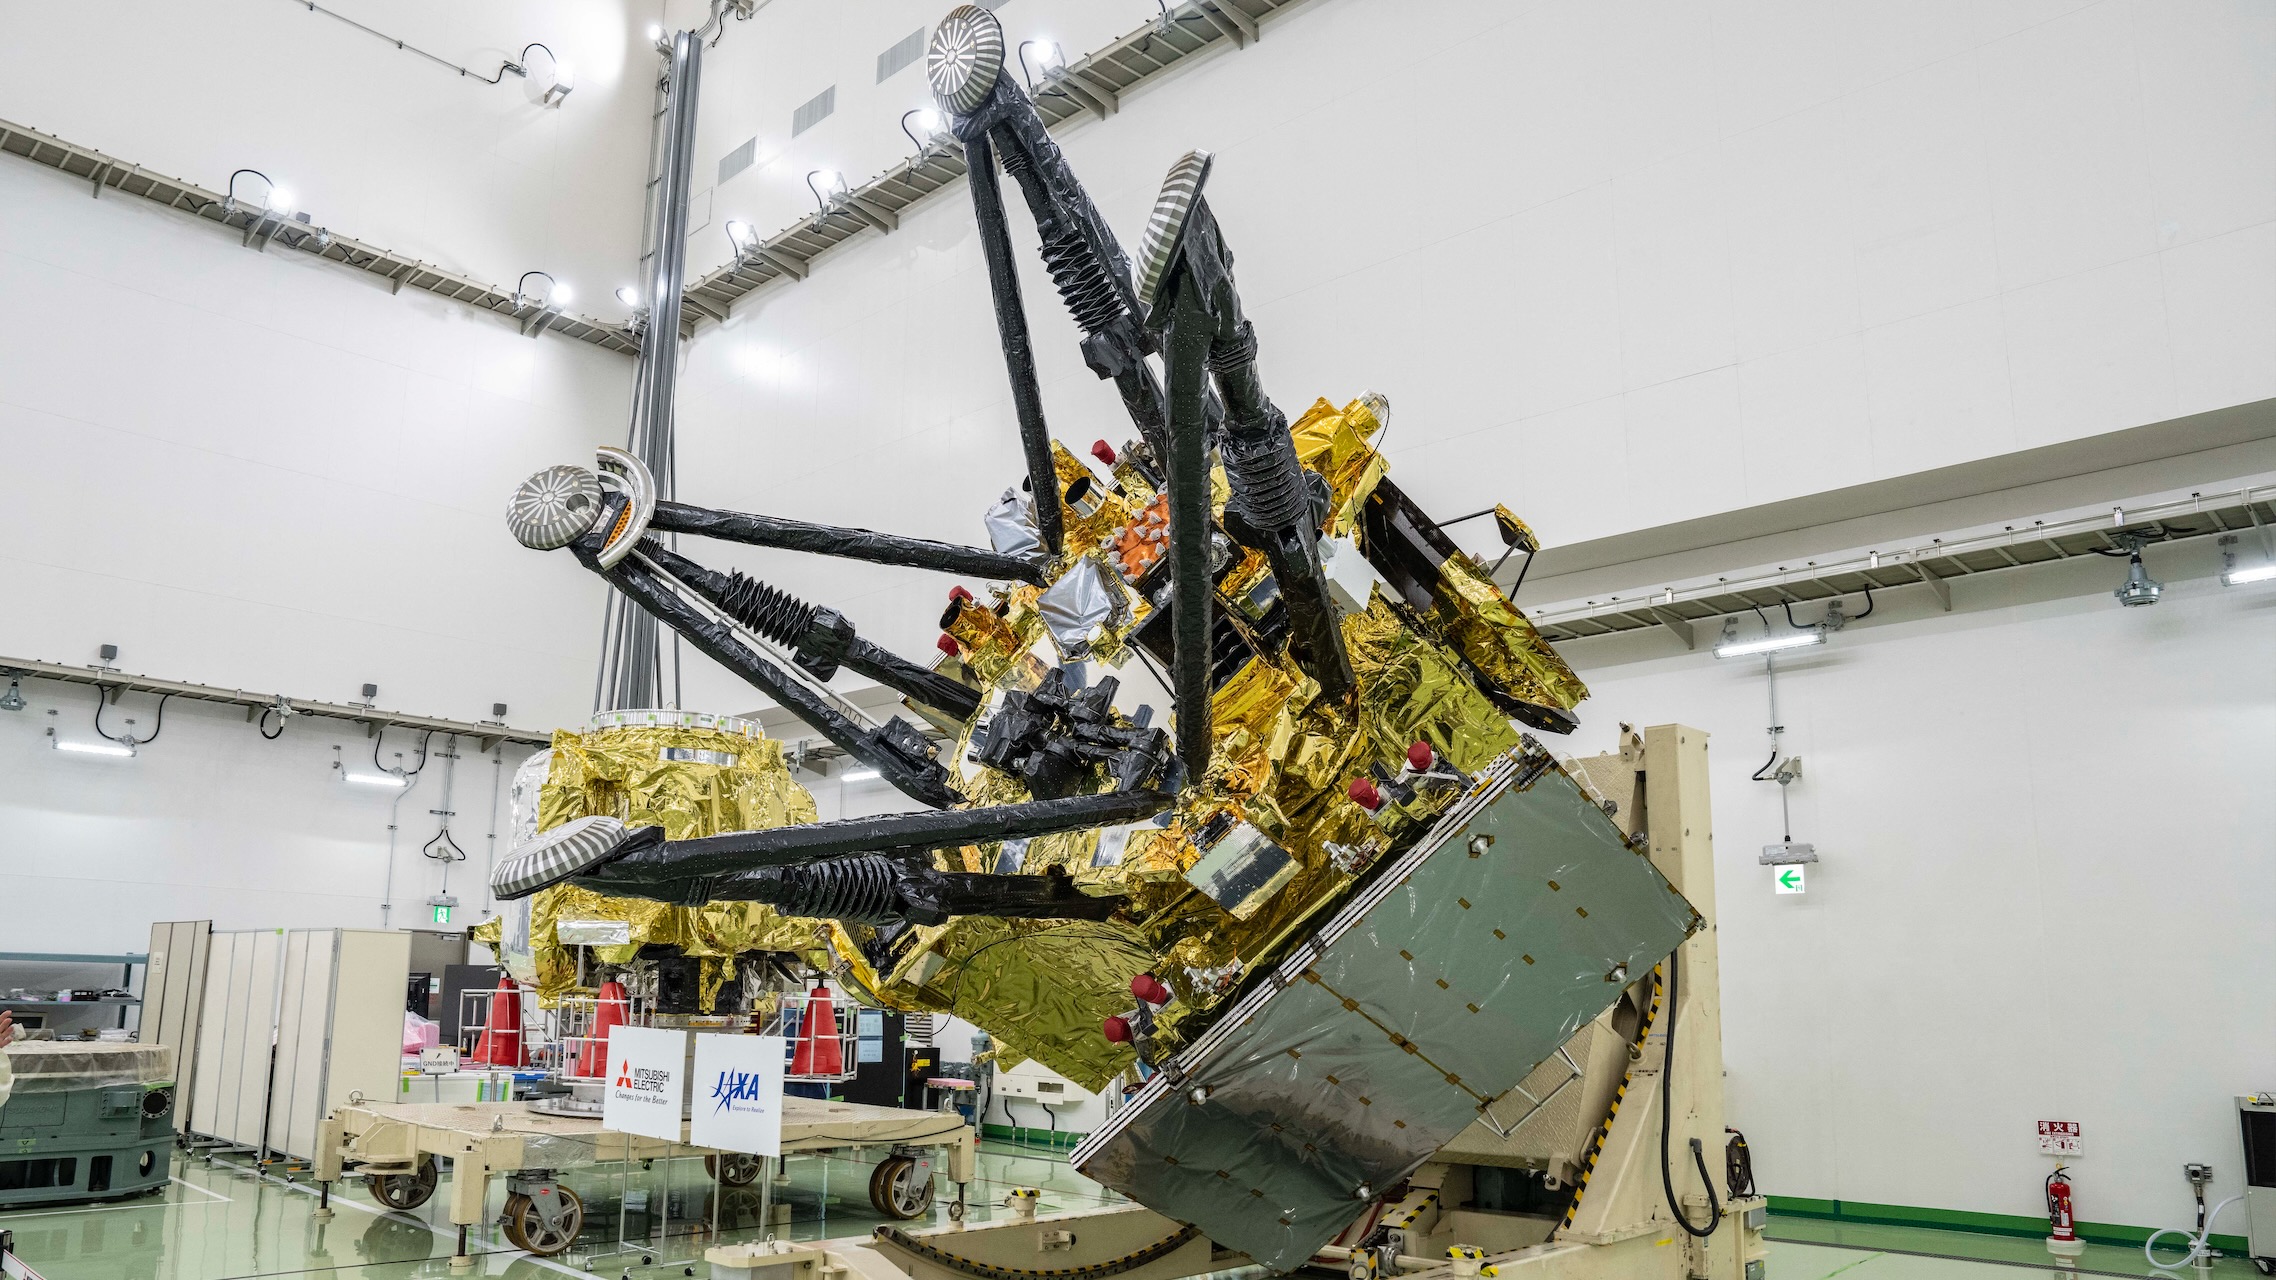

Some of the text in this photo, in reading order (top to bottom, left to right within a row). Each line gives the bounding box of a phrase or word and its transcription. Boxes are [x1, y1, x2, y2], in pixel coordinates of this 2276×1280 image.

[634, 1068, 670, 1082] MITSUBISHI
[633, 1079, 665, 1093] ELECTRIC
[709, 1066, 759, 1114] JAXA
[615, 1090, 634, 1101] Changes
[643, 1095, 651, 1103] the
[652, 1095, 668, 1105] Better
[2039, 1121, 2078, 1133] 消火器
